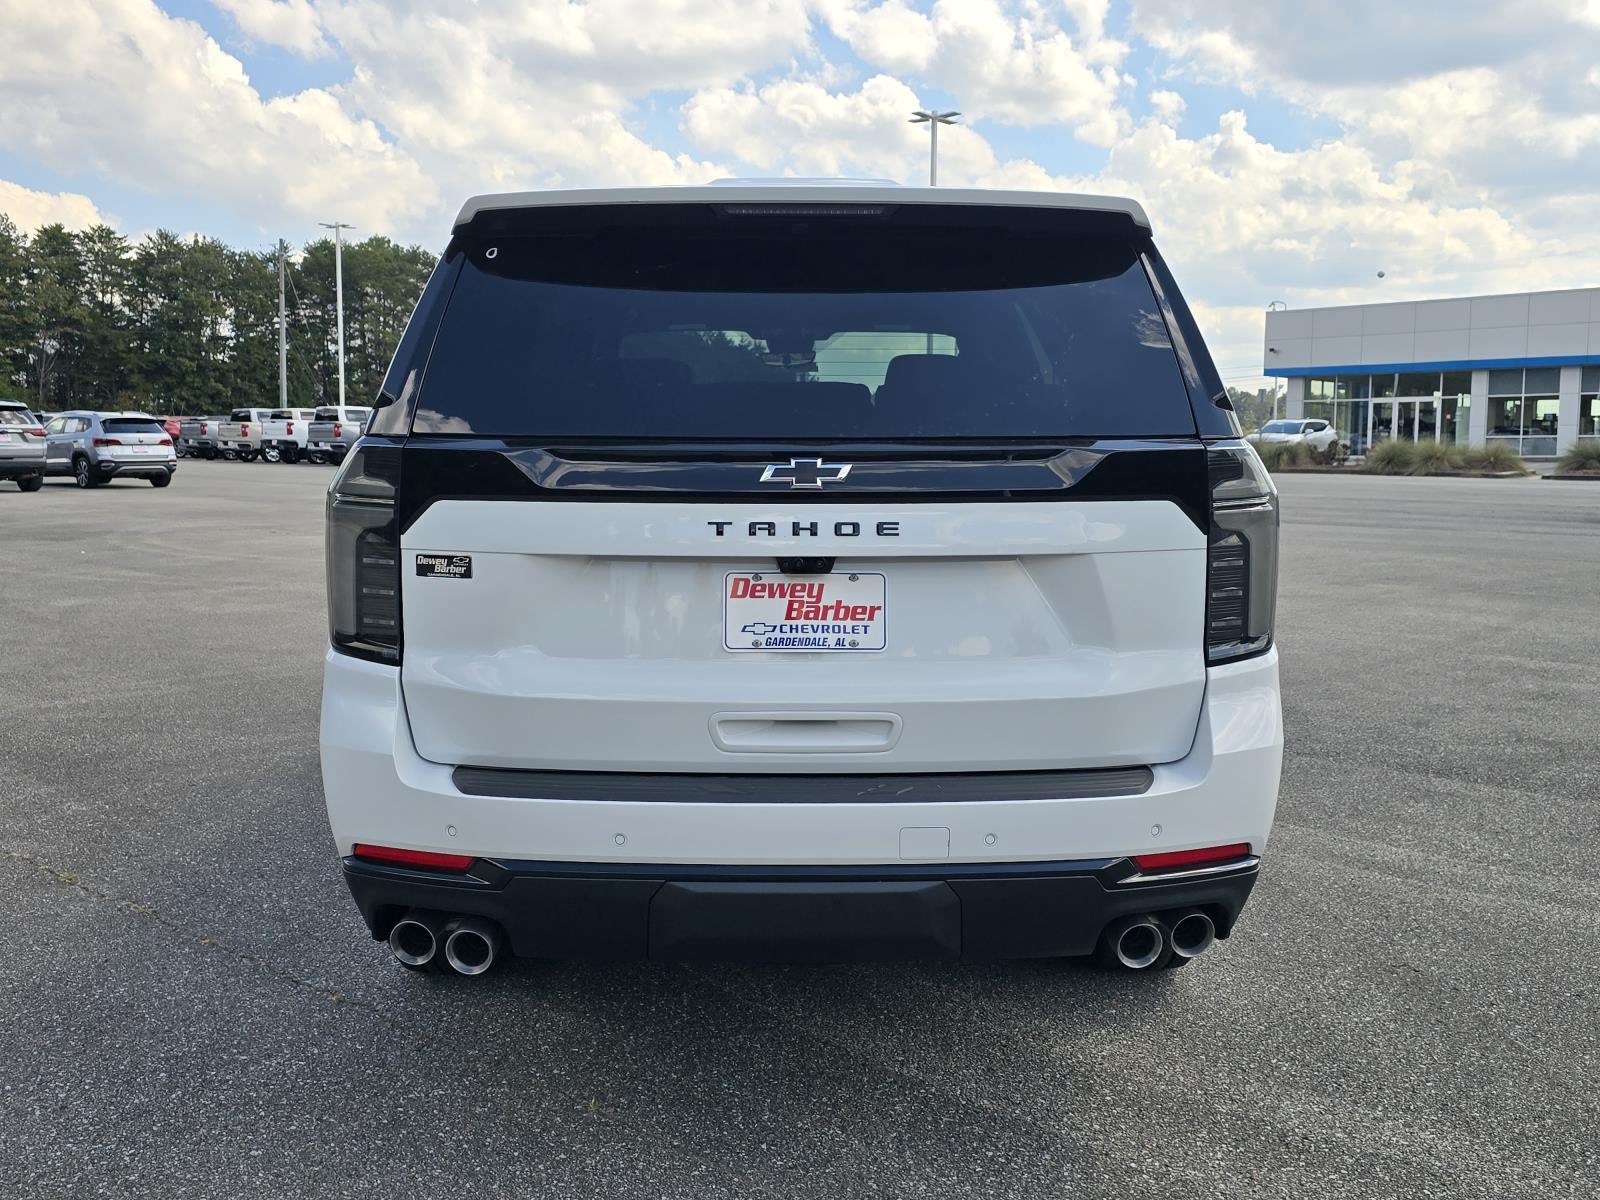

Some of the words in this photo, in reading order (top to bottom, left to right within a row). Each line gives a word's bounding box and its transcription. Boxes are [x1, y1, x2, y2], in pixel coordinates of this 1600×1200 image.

[707, 521, 900, 537] TAHOE
[416, 555, 448, 566] Dewey
[434, 564, 467, 574] Barber
[729, 577, 825, 604] Dewey
[784, 600, 882, 622] Barber
[779, 624, 871, 635] CHEVROLET
[765, 637, 831, 648] GARDENDALE,
[834, 637, 847, 647] AL
